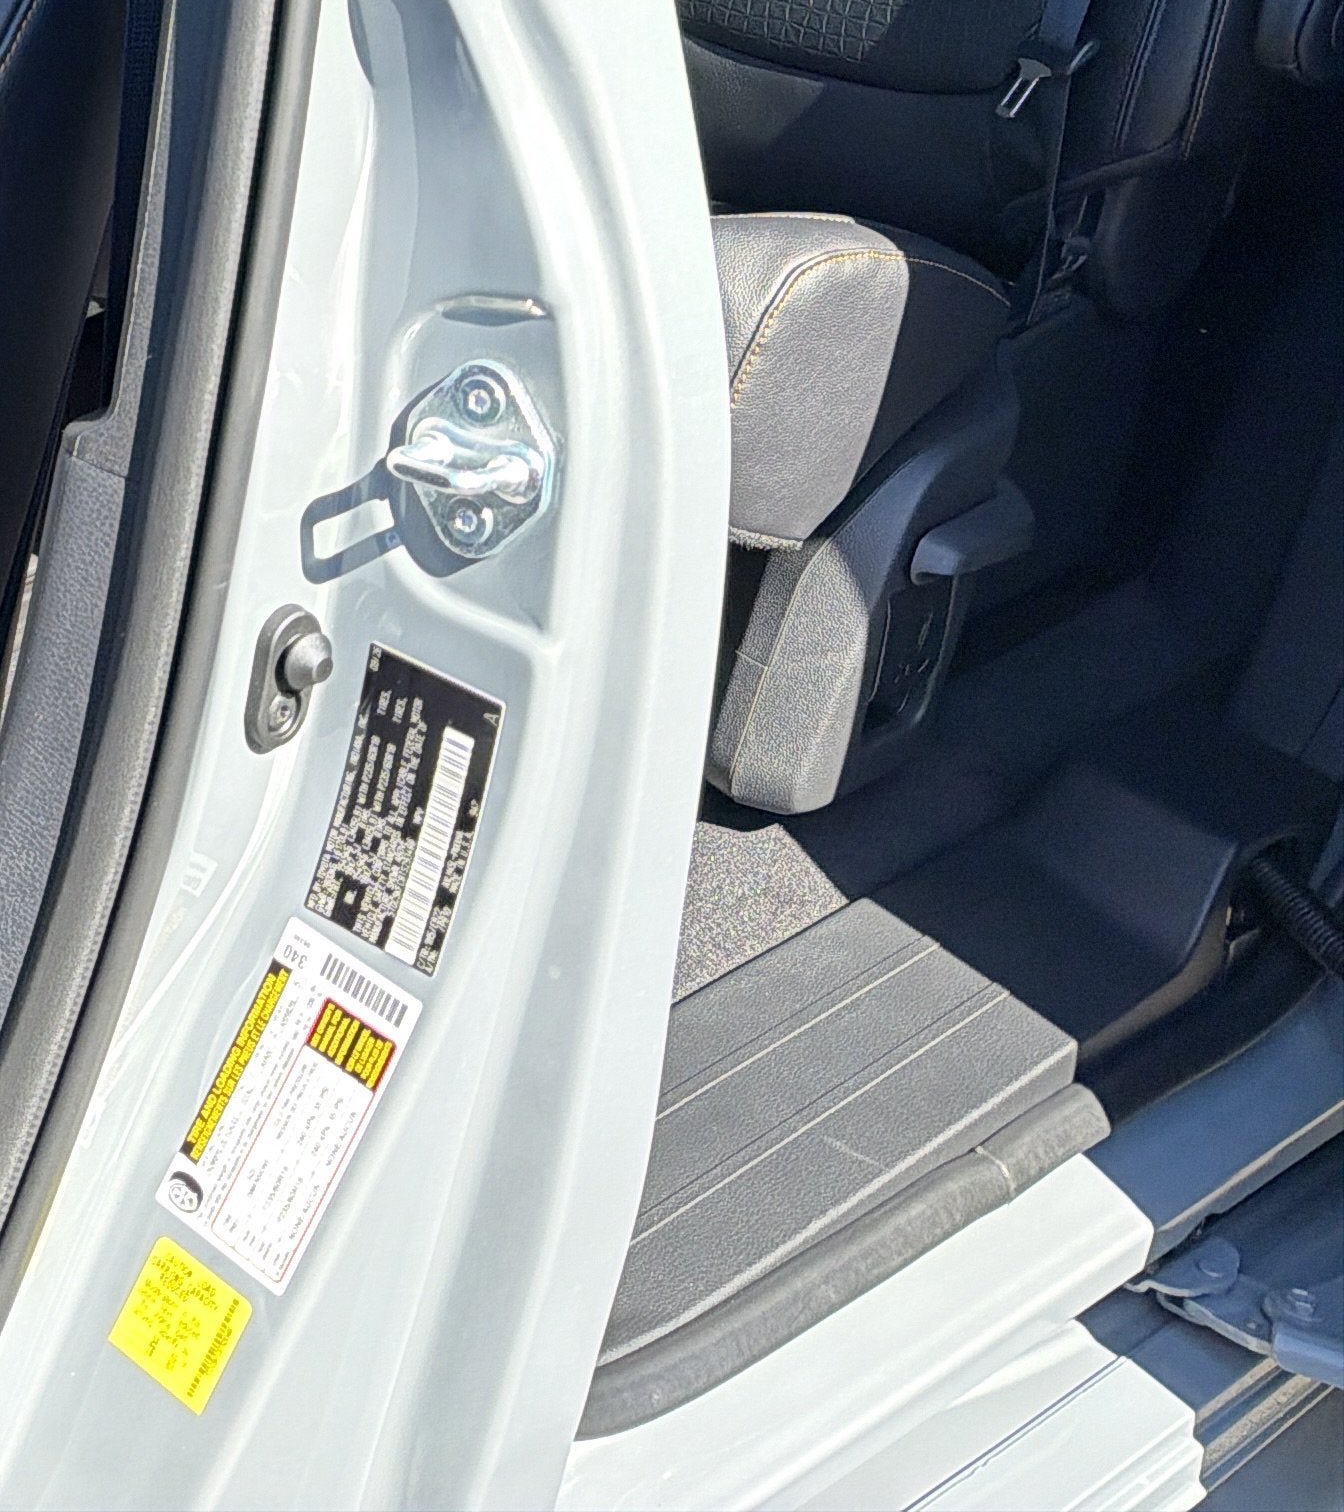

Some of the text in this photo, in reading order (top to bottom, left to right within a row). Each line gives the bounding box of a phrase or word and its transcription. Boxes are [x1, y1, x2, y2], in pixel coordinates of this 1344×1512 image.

[481, 708, 500, 727] A
[281, 942, 308, 970] 340
[258, 968, 290, 1021] CHARGEMENT
[249, 1028, 260, 1041] ET
[254, 1018, 265, 1031] LE
[186, 1116, 205, 1145] TIRE
[199, 1092, 218, 1119] AND
[211, 1044, 241, 1096] LOADING
[235, 971, 278, 1048] INFORMATION
[237, 1037, 256, 1066] PNEUS
[229, 1062, 244, 1080] LES
[221, 1077, 236, 1097] SUR
